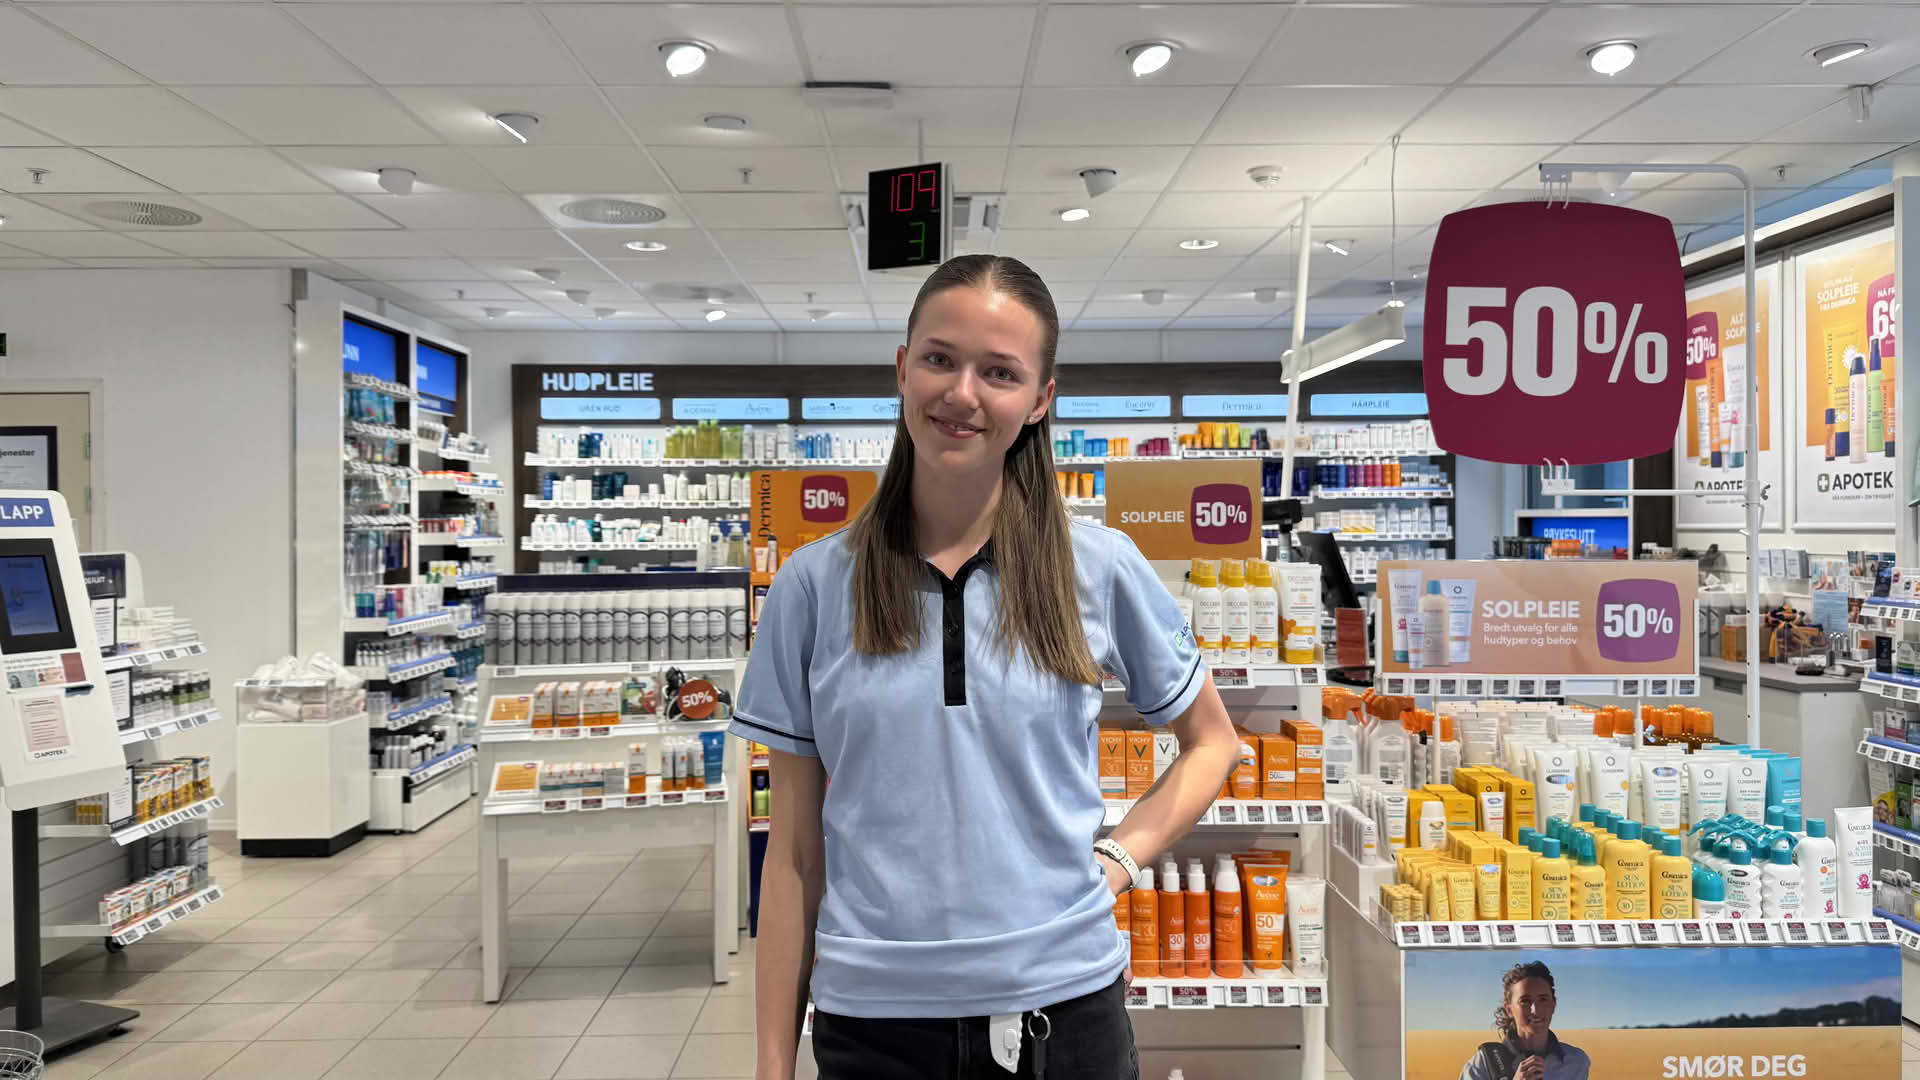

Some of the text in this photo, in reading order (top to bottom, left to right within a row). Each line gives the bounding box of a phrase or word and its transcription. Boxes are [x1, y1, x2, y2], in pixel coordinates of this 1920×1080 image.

[890, 169, 937, 213] 109
[907, 221, 926, 261] 3
[1442, 285, 1669, 397] 50%
[1686, 335, 1717, 366] 50%
[542, 372, 655, 392] HUDPLEIE
[1831, 471, 1894, 491] APOTEK
[758, 474, 771, 538] Dermica
[803, 488, 846, 510] 50%
[1120, 511, 1185, 524] SOLPLEIE
[1195, 501, 1248, 527] 50%
[1481, 600, 1580, 618] SOLPLEIE
[1483, 623, 1578, 635] Bredt utvalg for alle
[1603, 603, 1674, 638] 50%
[1483, 634, 1576, 647] hudtyper og behov
[681, 691, 713, 708] 50%
[1170, 934, 1183, 945] 30
[1194, 934, 1207, 945] 30
[1662, 1054, 1807, 1078] SMØR DEG
